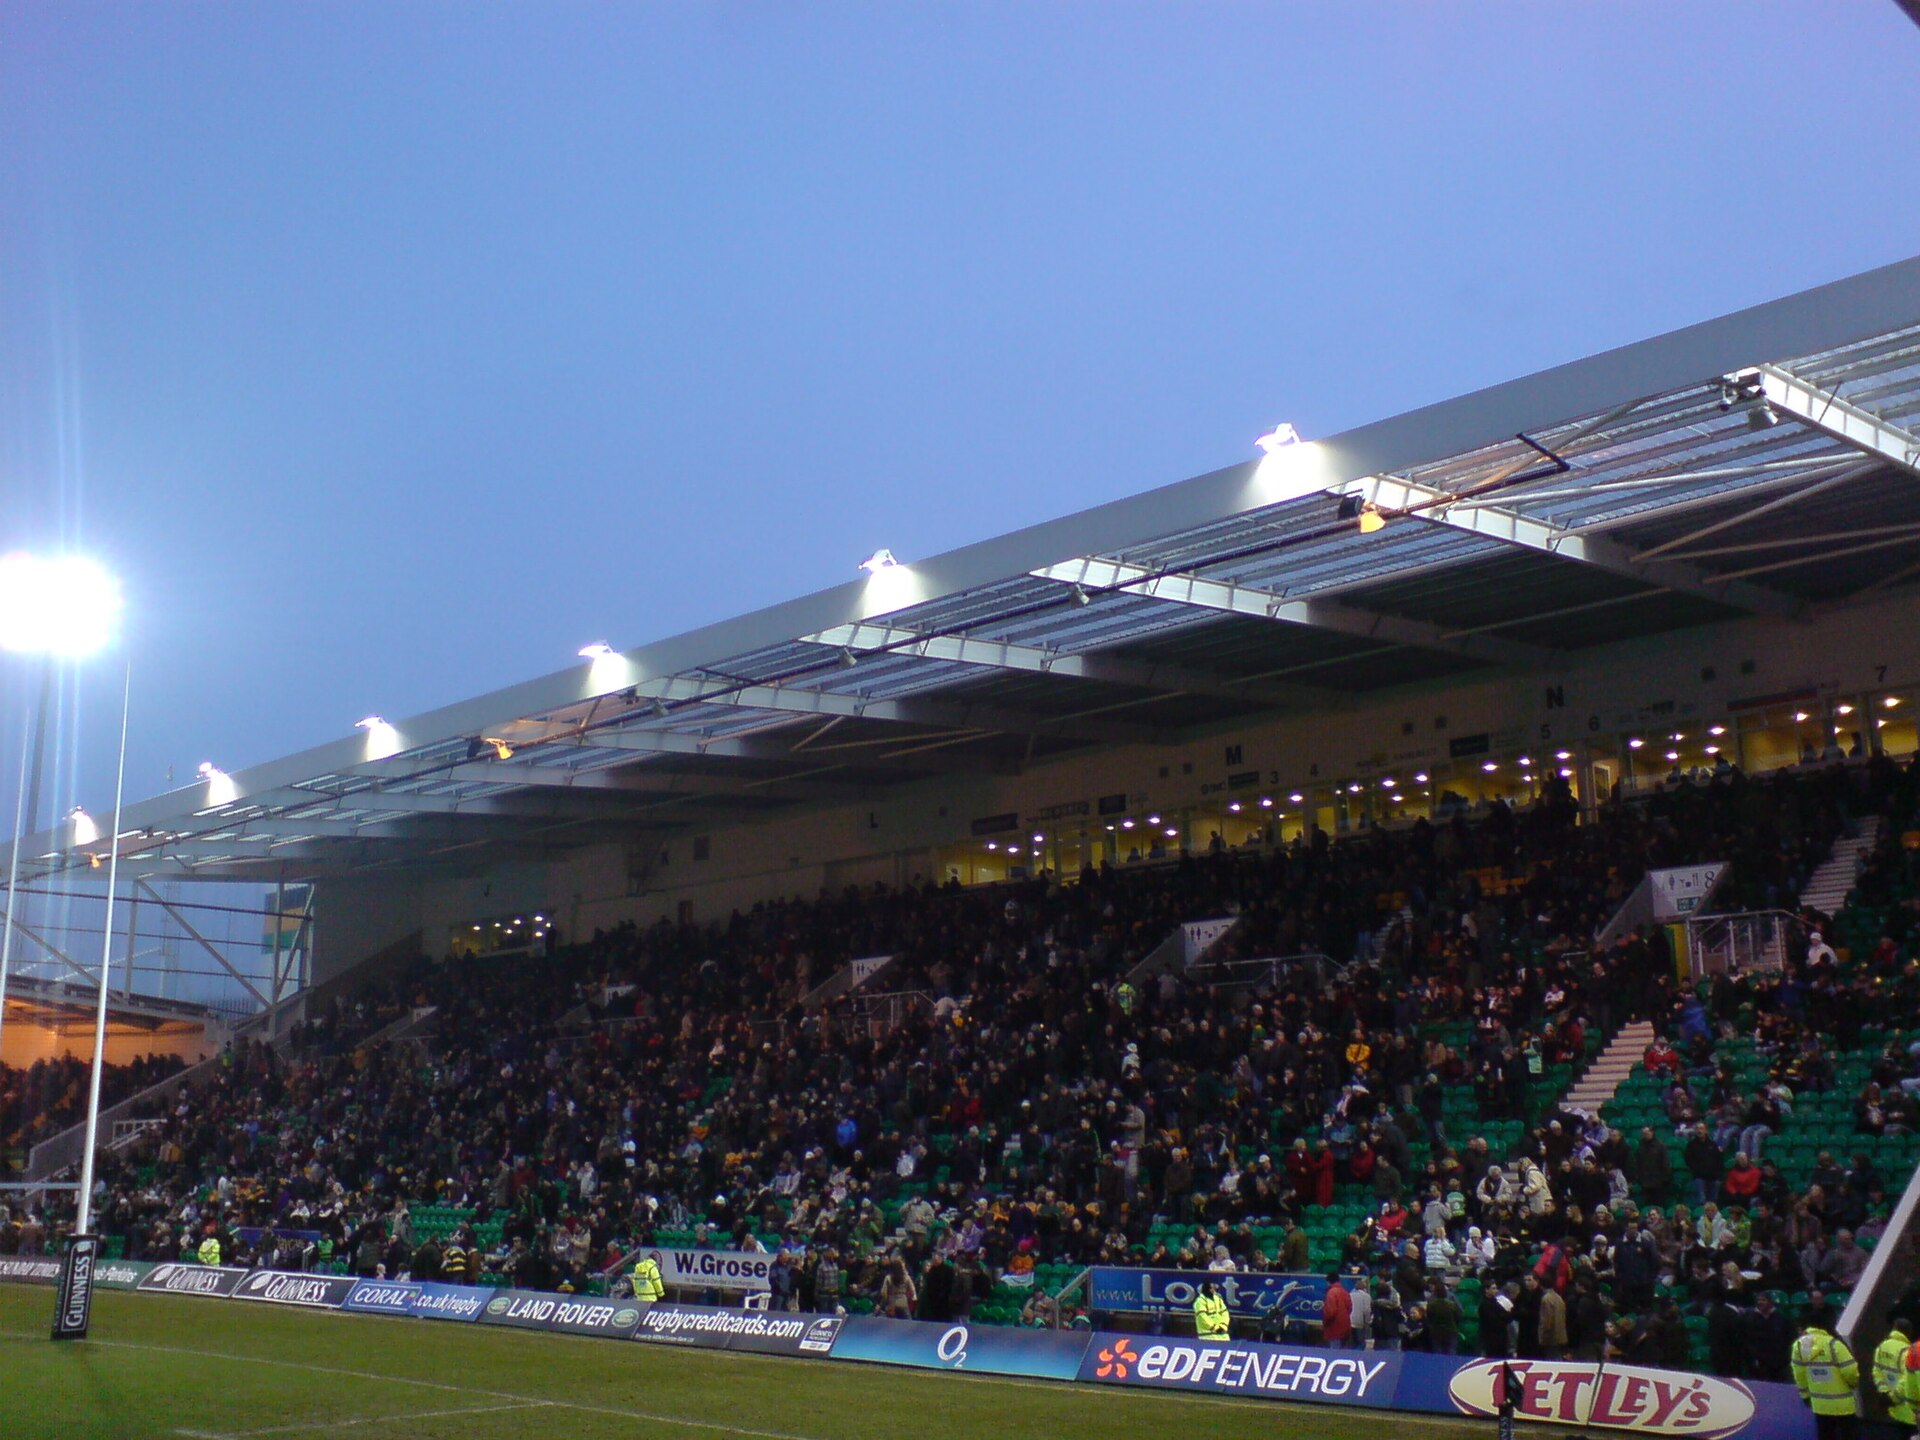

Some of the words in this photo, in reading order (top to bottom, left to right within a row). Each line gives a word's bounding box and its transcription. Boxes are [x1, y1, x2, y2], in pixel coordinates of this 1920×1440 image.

[1875, 666, 1887, 682] 7
[1546, 686, 1564, 709] N
[1541, 724, 1551, 739] 5
[1589, 716, 1600, 731] 6
[1226, 745, 1242, 765] M
[1270, 771, 1279, 784] 3
[1309, 763, 1318, 777] 4
[869, 812, 878, 828] L
[1704, 871, 1715, 889] 8
[674, 1252, 768, 1278] W.Grose
[166, 1267, 224, 1291] GUINNESS
[265, 1275, 331, 1302] GUINNESS
[65, 1256, 91, 1327] GUINNESS
[354, 1287, 408, 1305] CORAL
[506, 1298, 555, 1321] LAND
[551, 1302, 614, 1327] ROVER
[642, 1309, 805, 1338] rugbycreditcards.com
[1216, 1351, 1387, 1397] ENERGY
